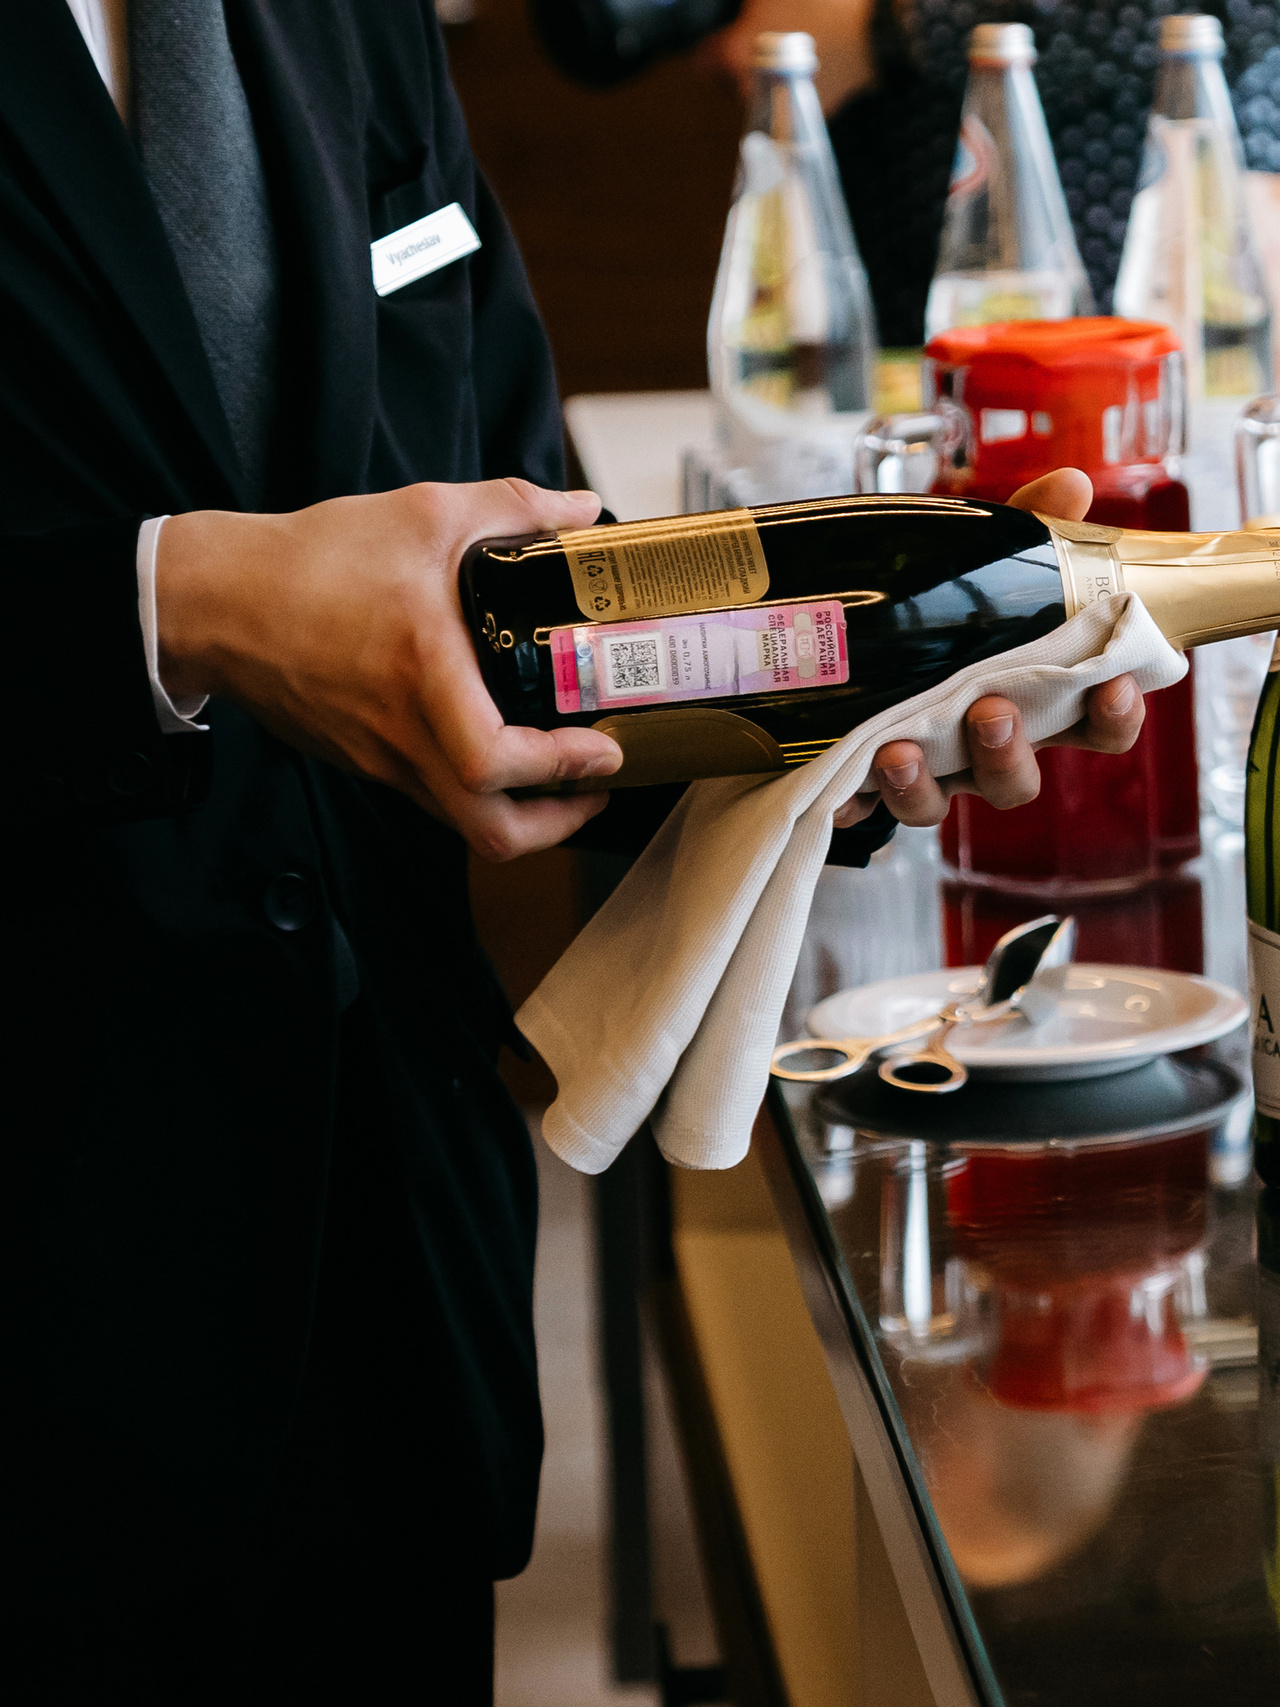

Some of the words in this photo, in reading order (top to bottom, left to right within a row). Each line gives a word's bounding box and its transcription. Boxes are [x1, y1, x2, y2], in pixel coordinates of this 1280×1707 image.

[385, 233, 441, 267] Vyacheslav
[745, 556, 757, 574] SWEET
[683, 651, 692, 673] 0,75
[762, 633, 771, 667] МАРКА
[768, 614, 781, 683] СПЕЦИАЛЬНАЯ
[777, 613, 789, 682] ФЕДЕРАЛЬНАЯ
[816, 611, 828, 676] ФЕДЕРАЦИЯ
[823, 610, 836, 675] РОССИЙСКАЯ
